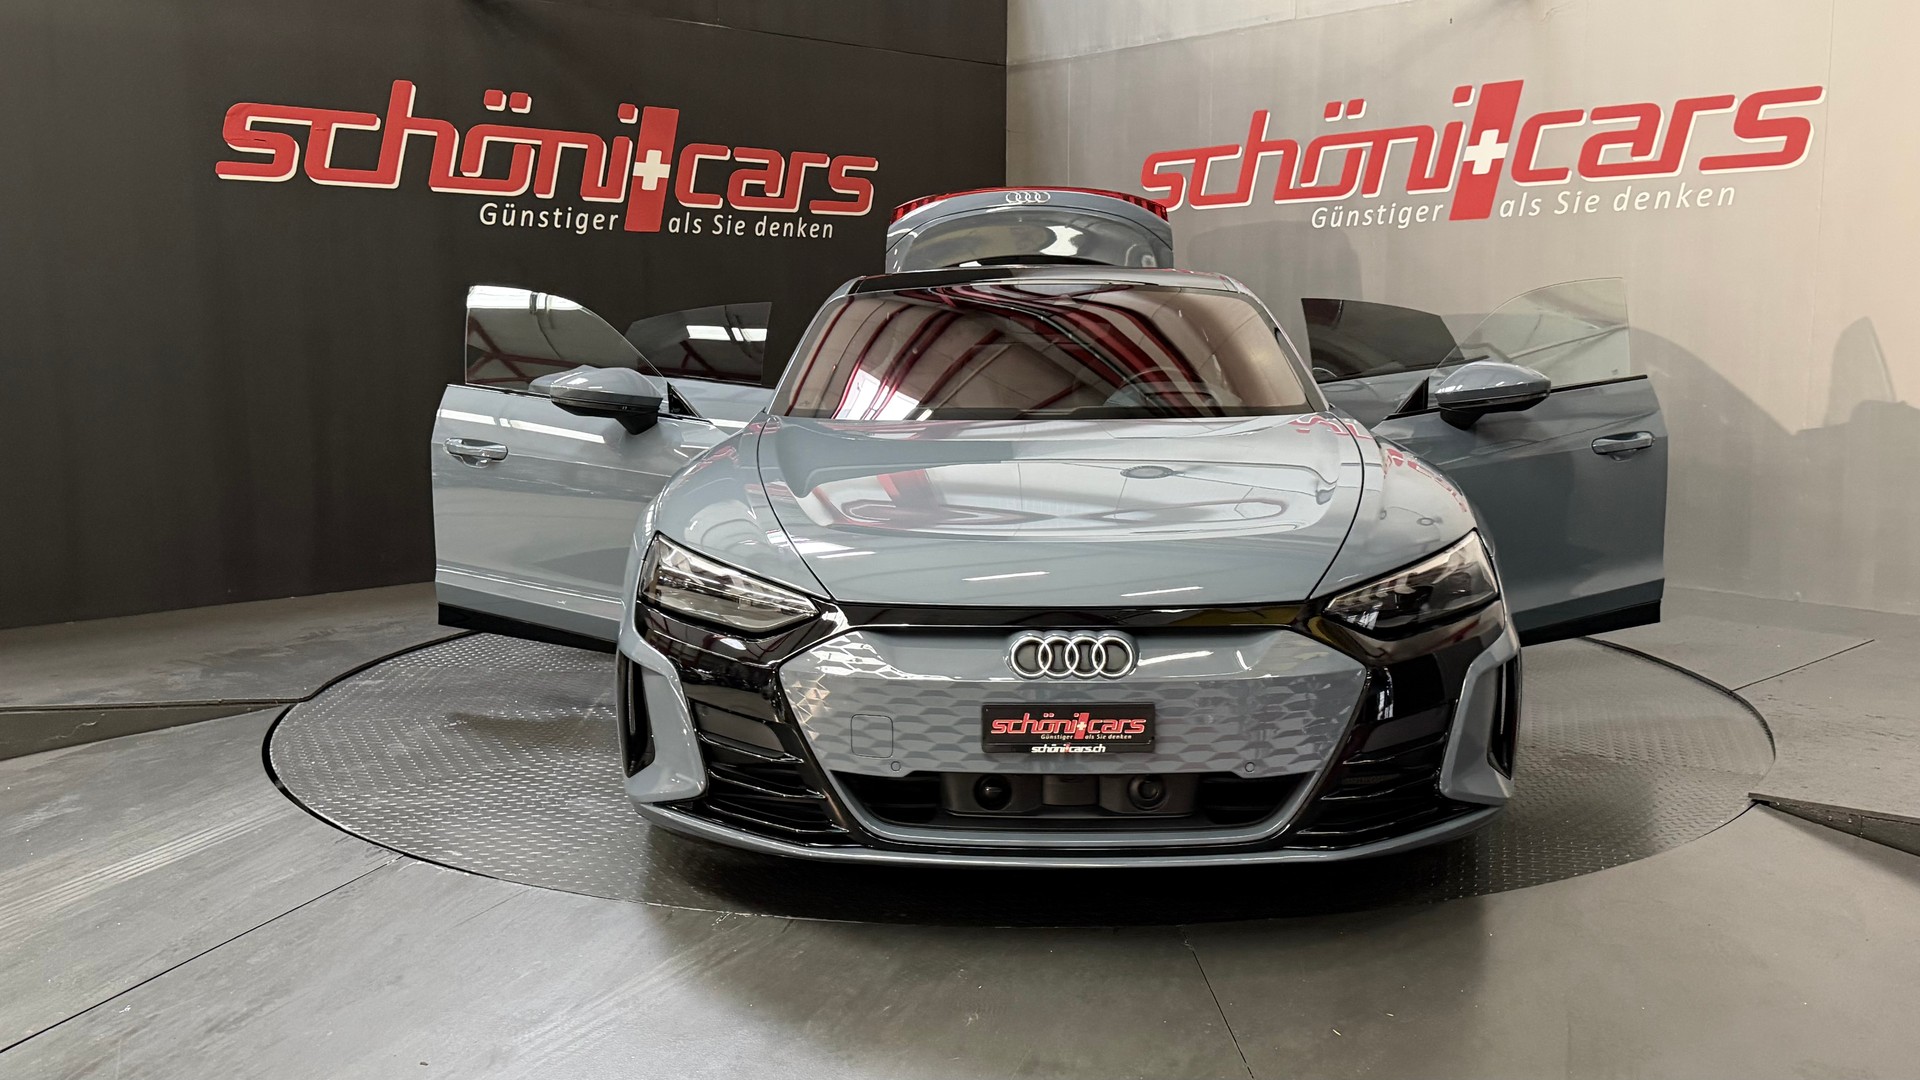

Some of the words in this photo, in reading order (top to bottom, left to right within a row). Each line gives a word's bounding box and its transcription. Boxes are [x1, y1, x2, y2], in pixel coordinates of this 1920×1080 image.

[479, 202, 619, 235] Günstiger
[667, 211, 703, 234] als
[712, 213, 747, 237] Sie
[754, 215, 835, 240] denken
[1311, 202, 1444, 229] Günstiger
[1500, 192, 1542, 218] als
[1554, 189, 1601, 215] Sie
[1613, 182, 1735, 212] denken
